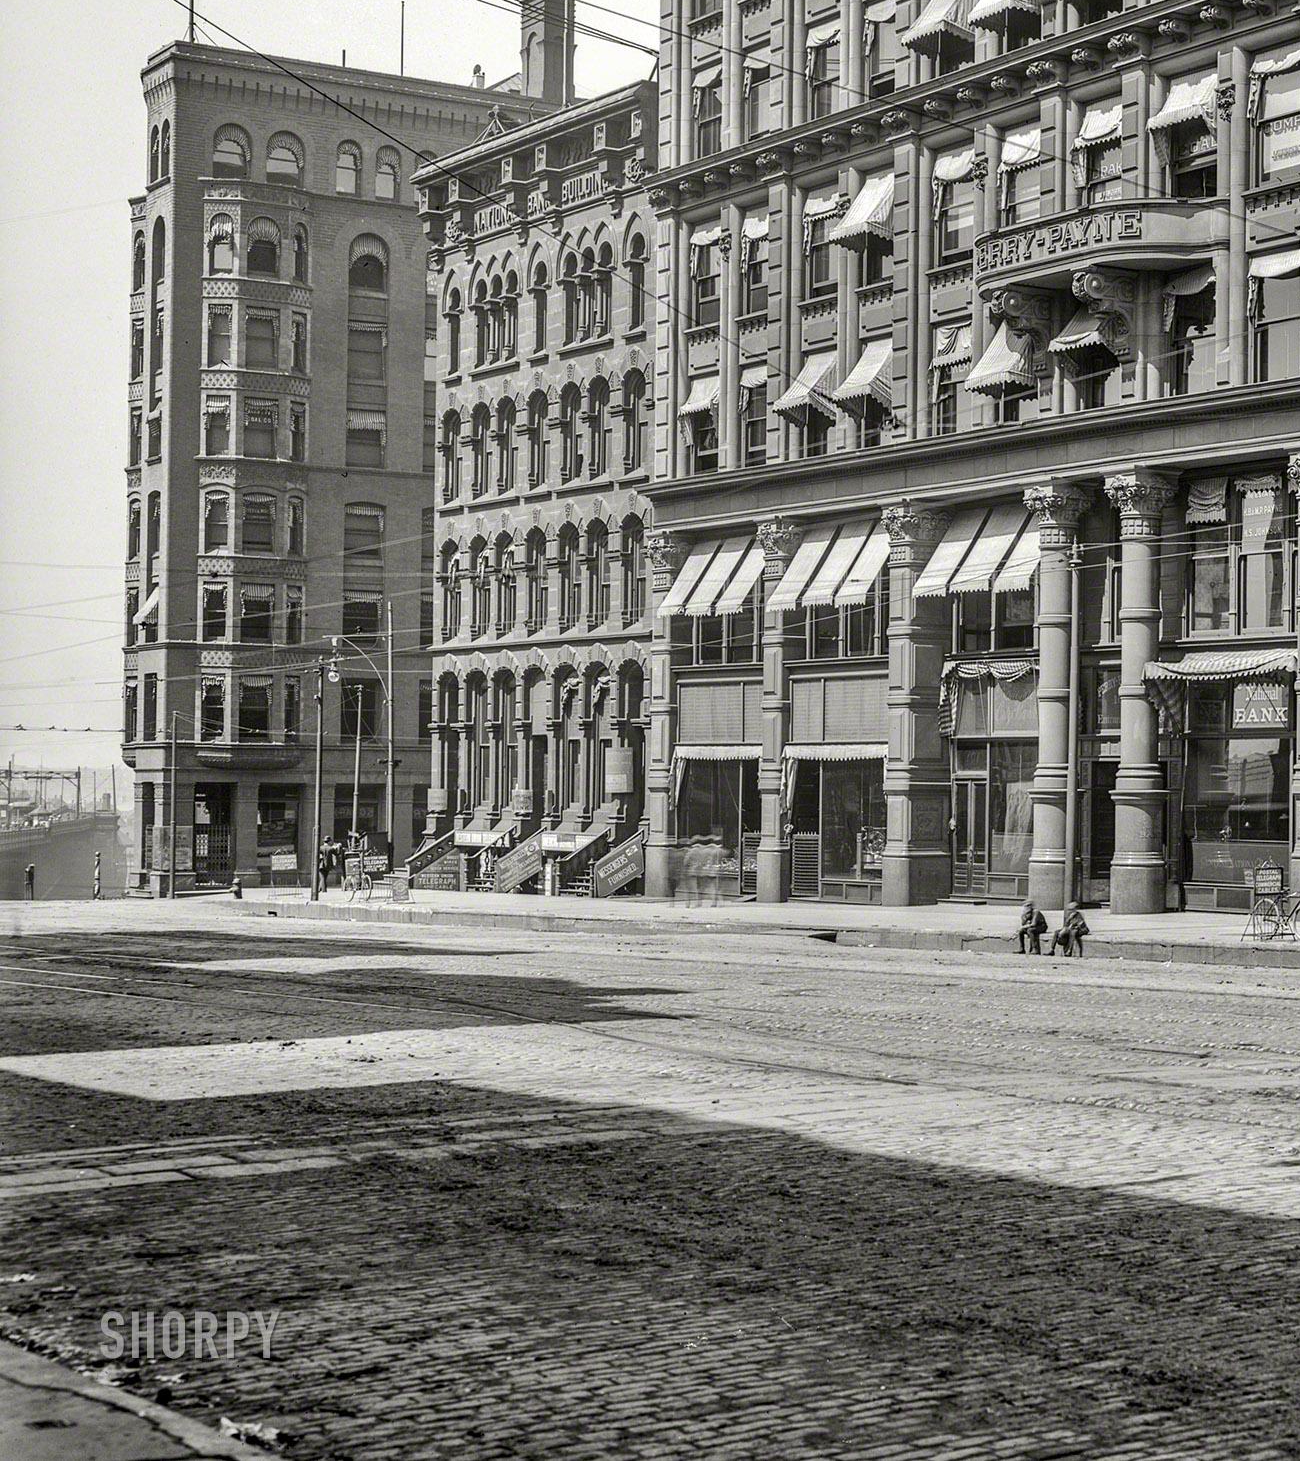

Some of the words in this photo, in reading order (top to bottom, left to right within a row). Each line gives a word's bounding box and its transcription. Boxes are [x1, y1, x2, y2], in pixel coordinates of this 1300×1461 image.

[474, 202, 520, 235] NATIONA
[977, 210, 1141, 274] ERRY-PAYNE
[1234, 707, 1289, 724] BANK
